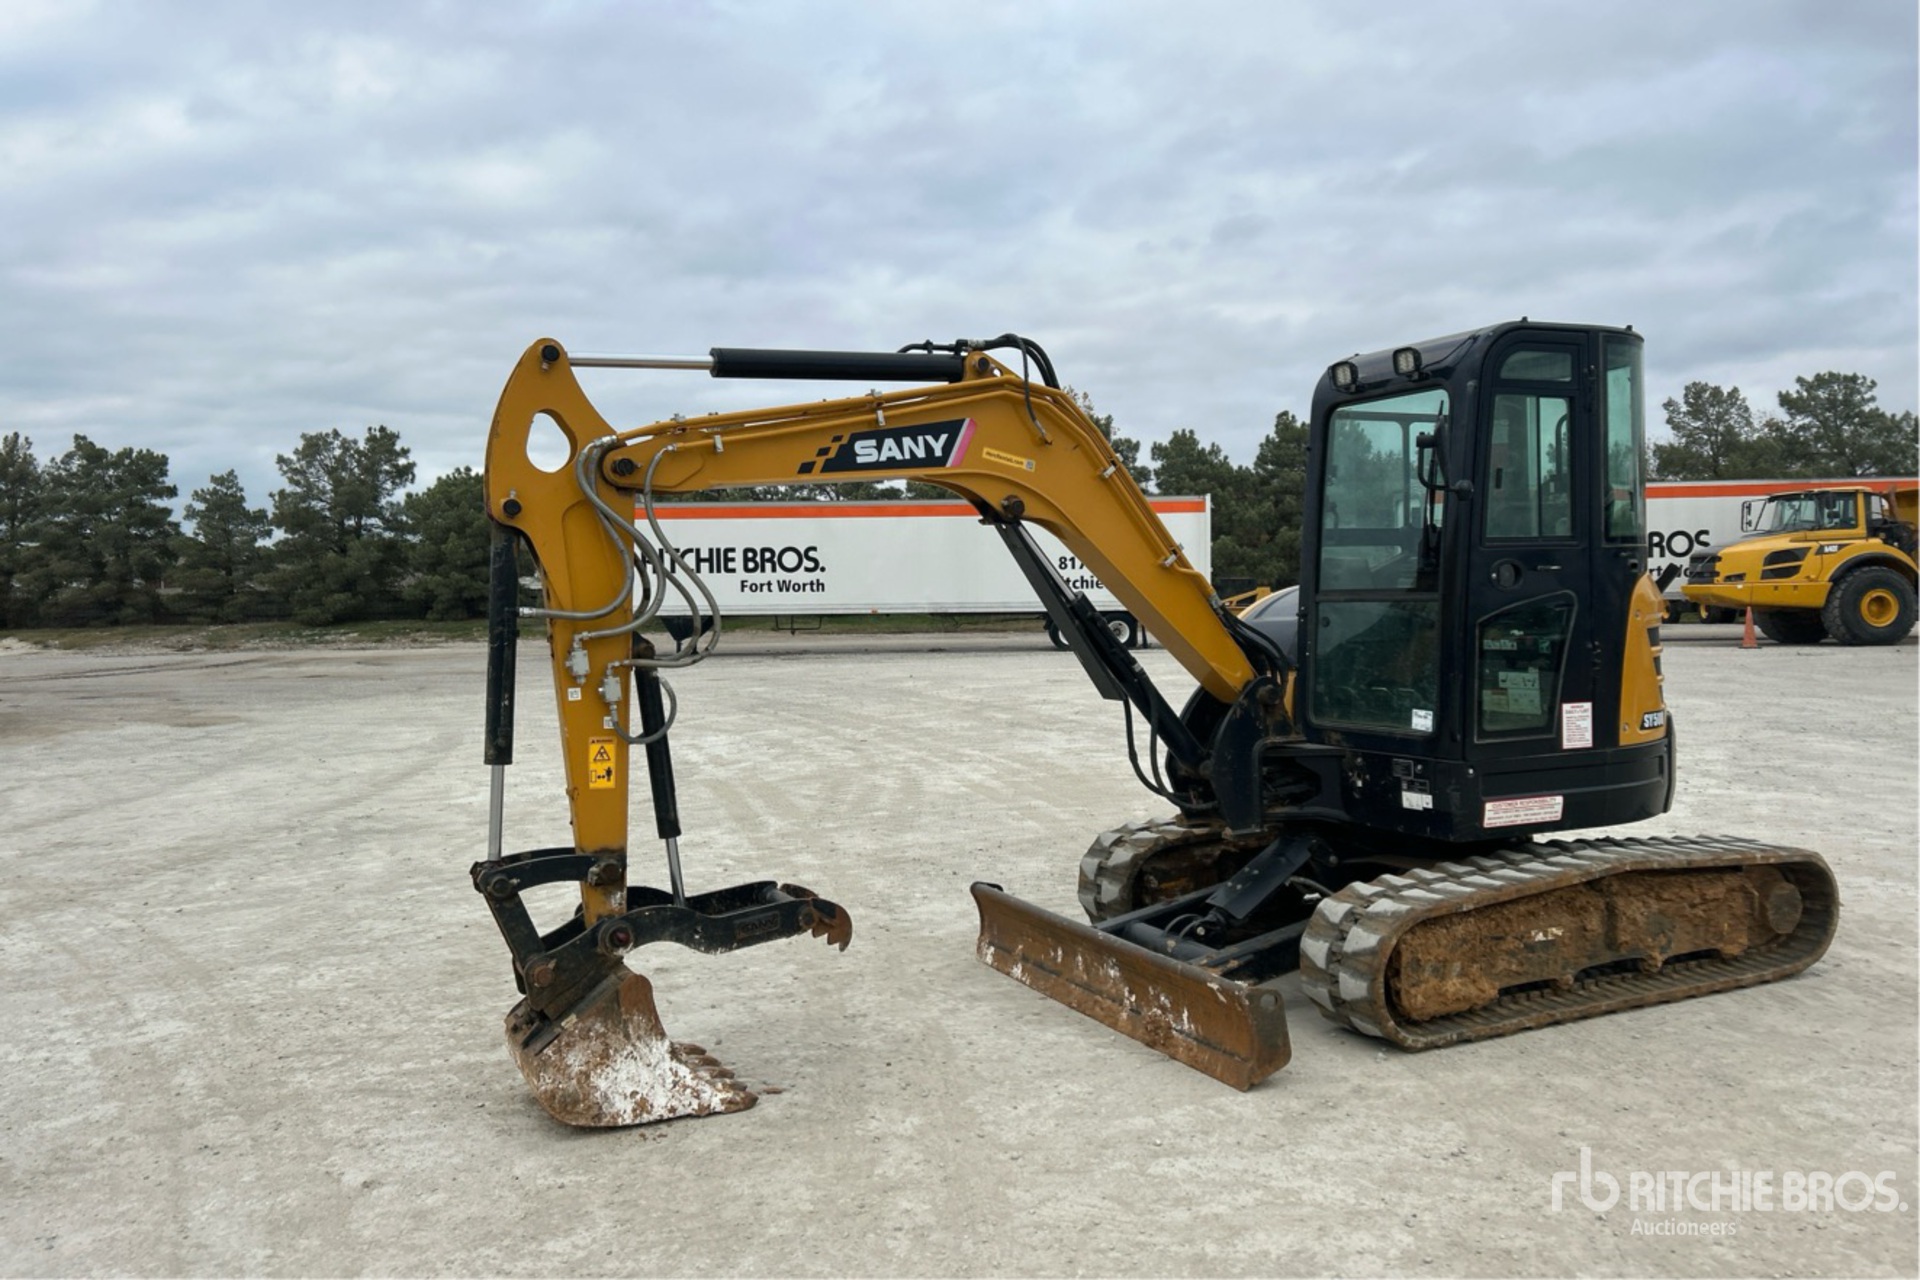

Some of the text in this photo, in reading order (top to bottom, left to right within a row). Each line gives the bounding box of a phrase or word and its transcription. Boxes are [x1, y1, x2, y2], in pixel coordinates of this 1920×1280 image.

[854, 433, 949, 464] SANY
[743, 546, 826, 573] BROS.
[740, 579, 826, 593] Fort Worth
[1062, 576, 1104, 590] tchie
